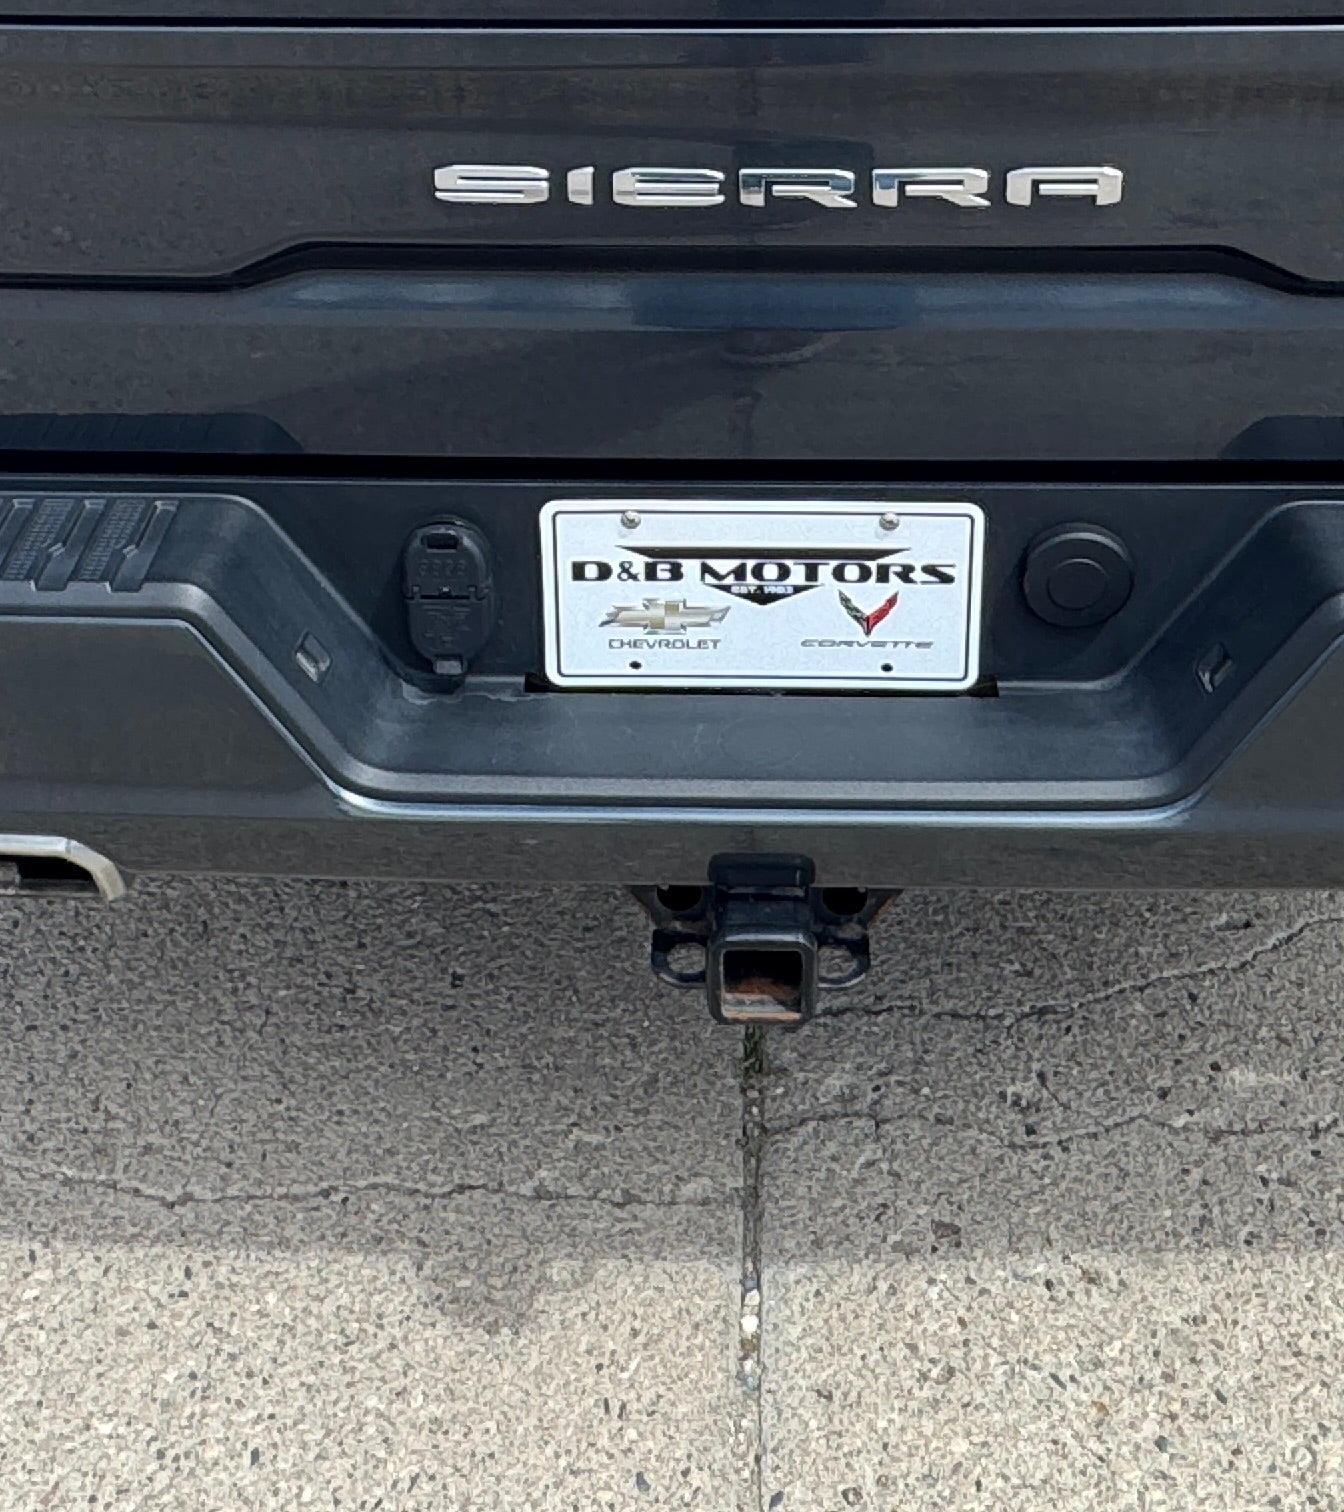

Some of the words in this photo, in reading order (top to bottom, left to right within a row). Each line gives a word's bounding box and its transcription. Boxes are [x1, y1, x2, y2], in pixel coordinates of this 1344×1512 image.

[433, 164, 1124, 209] SIERRA
[570, 559, 685, 583] D&B
[699, 560, 958, 585] MOTORS
[607, 637, 722, 650] CHEVROLET
[799, 639, 936, 649] CORVETTE
